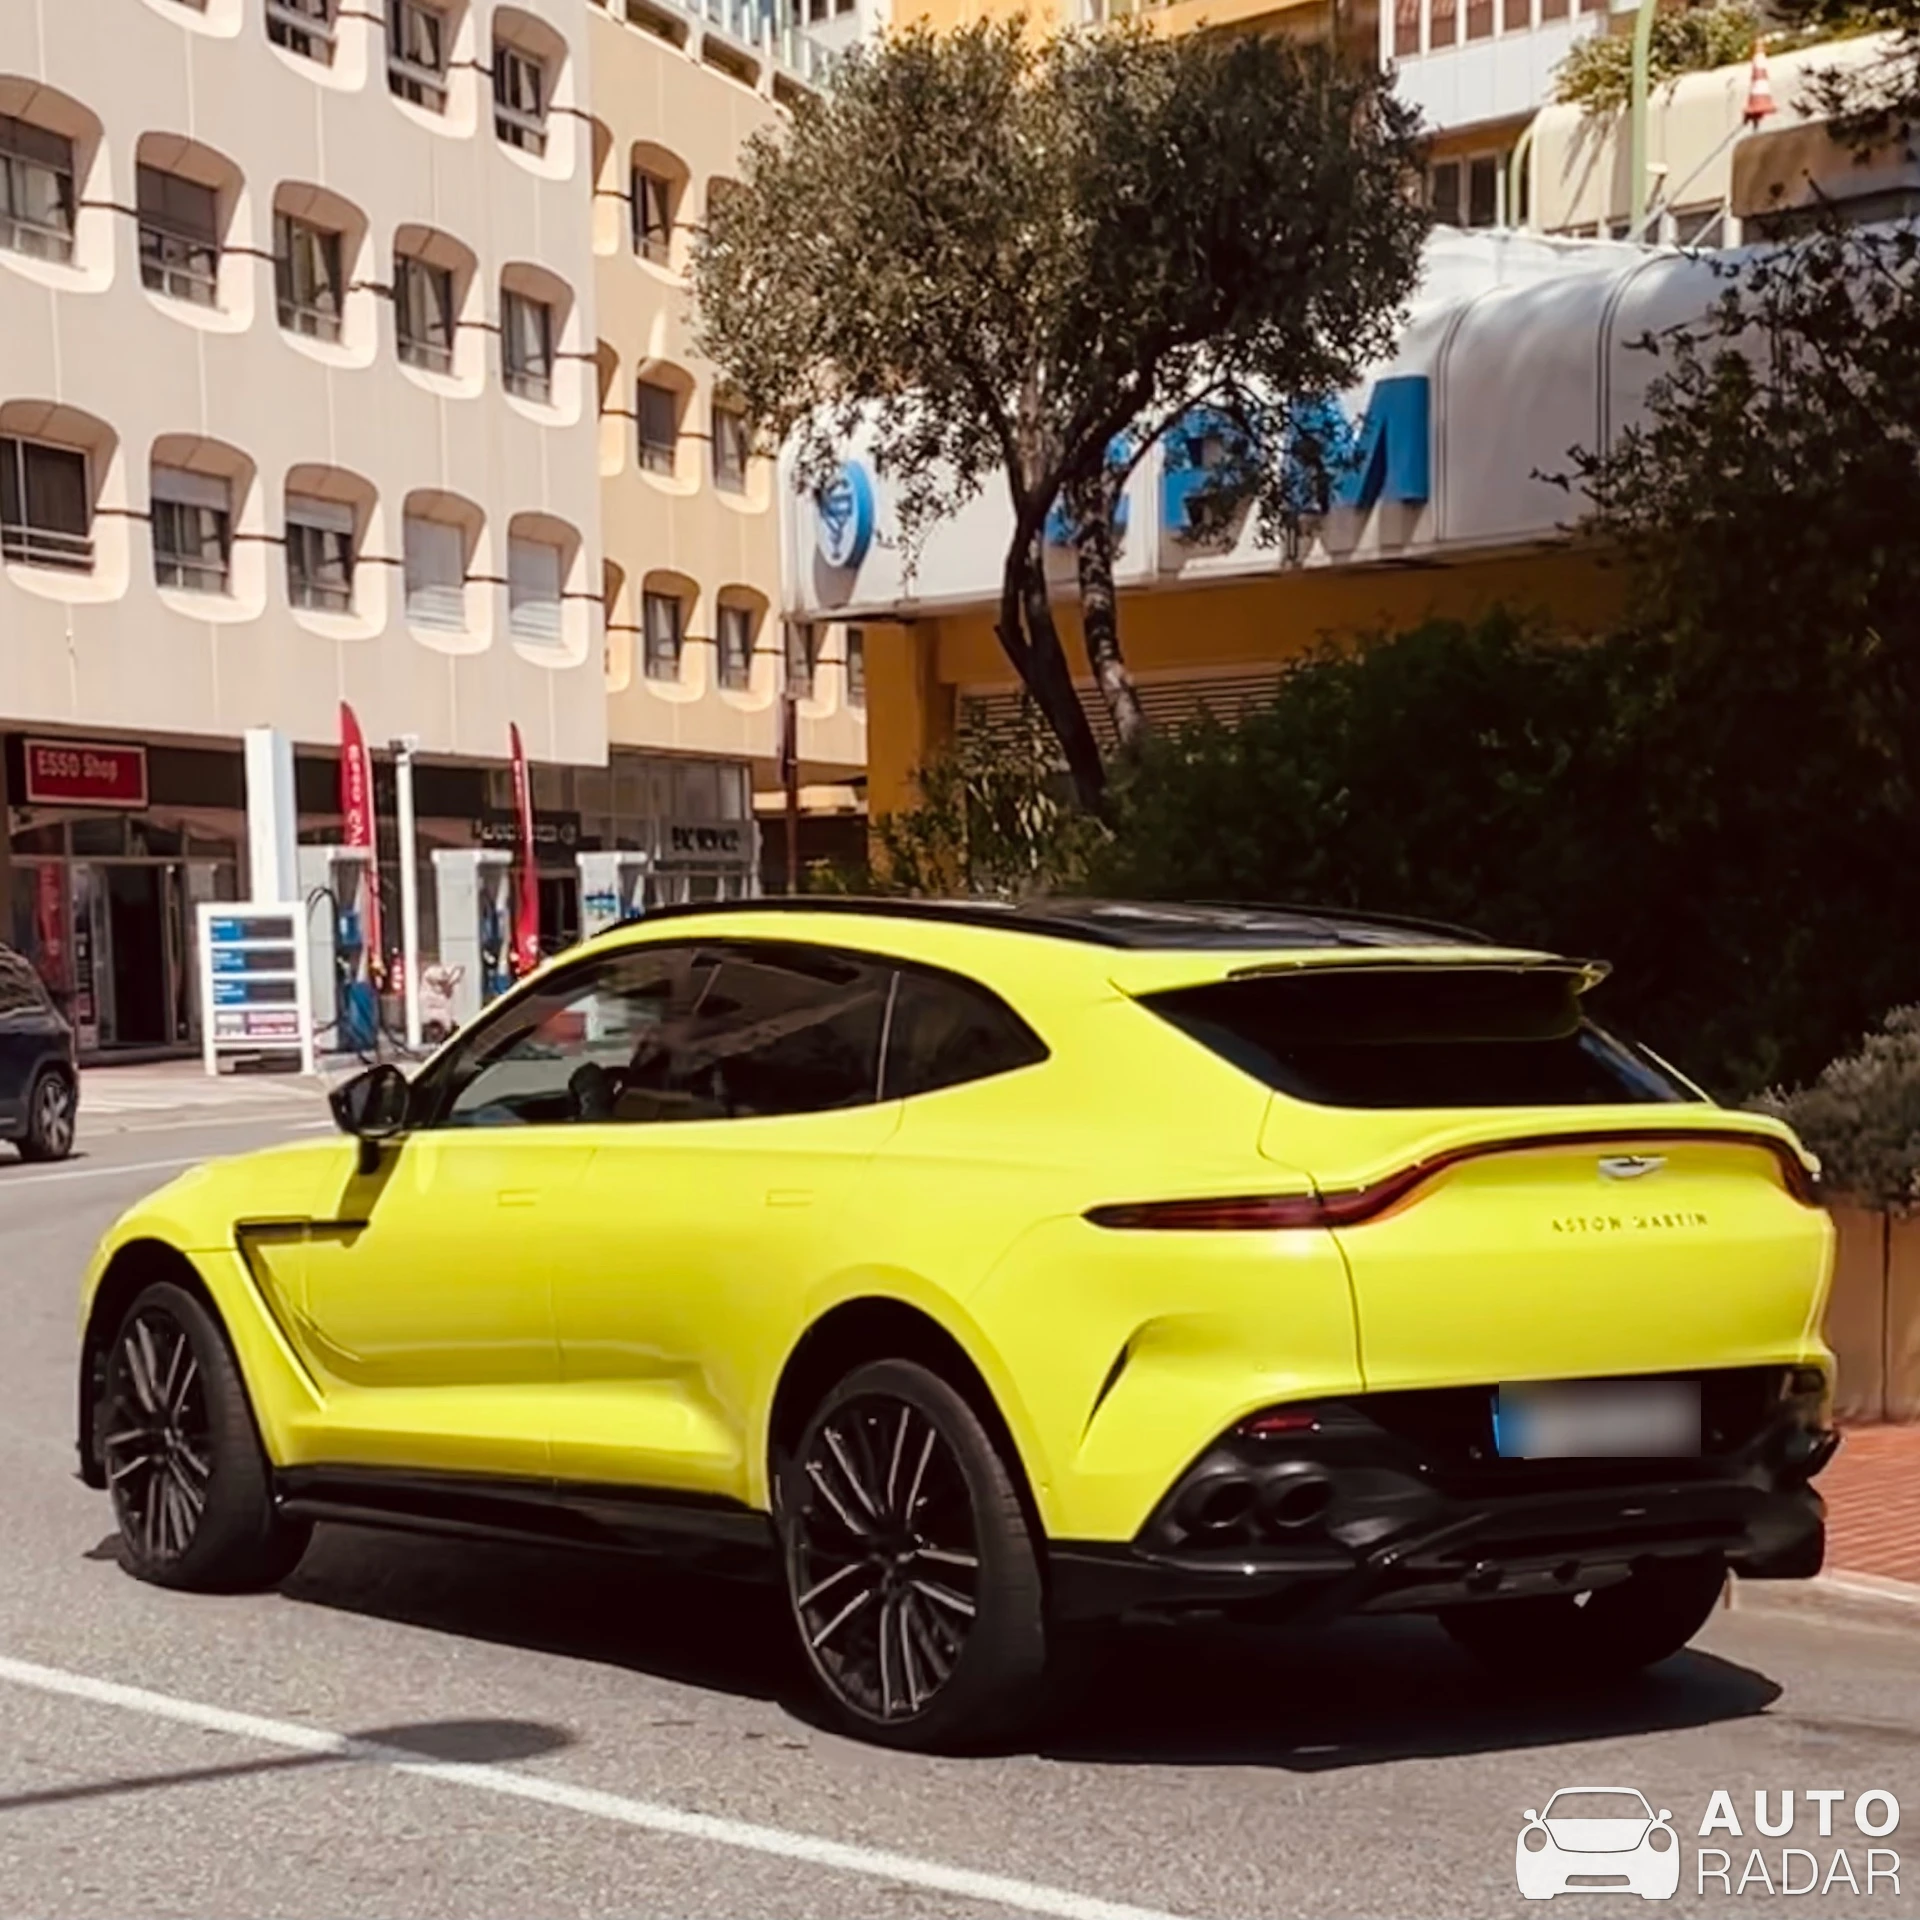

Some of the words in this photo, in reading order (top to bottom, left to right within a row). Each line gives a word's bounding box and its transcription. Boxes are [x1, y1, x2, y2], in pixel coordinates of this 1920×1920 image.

[83, 752, 118, 784] Shop
[1551, 1215, 1622, 1233] ASTON
[1633, 1211, 1708, 1230] MARTIN
